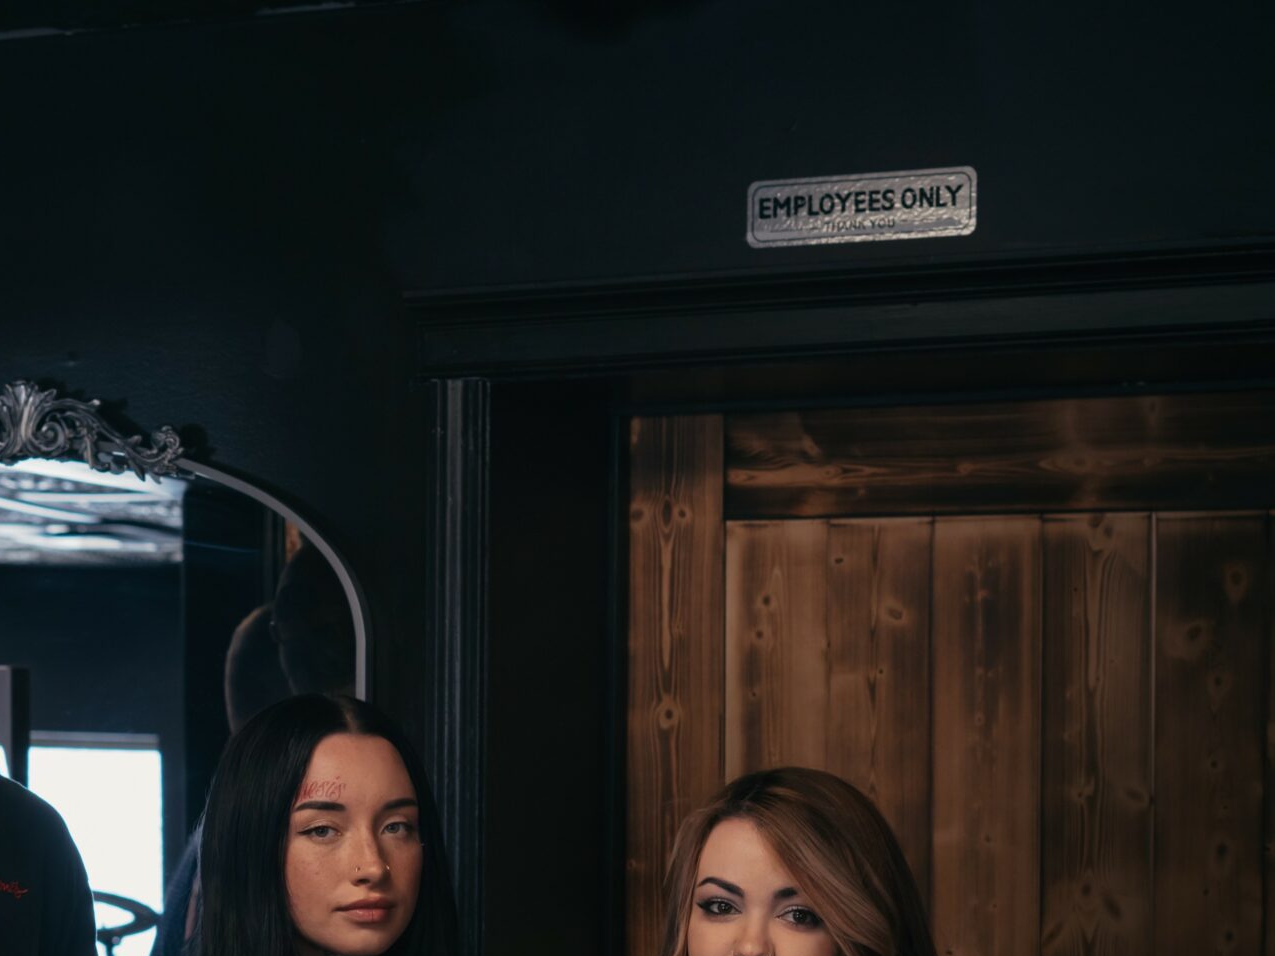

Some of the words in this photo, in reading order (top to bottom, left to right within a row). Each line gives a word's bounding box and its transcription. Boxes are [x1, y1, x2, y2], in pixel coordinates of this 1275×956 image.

[758, 189, 896, 219] EMPLOYEES
[900, 184, 964, 210] ONLY
[825, 219, 865, 232] THANK
[868, 217, 896, 230] YOU
